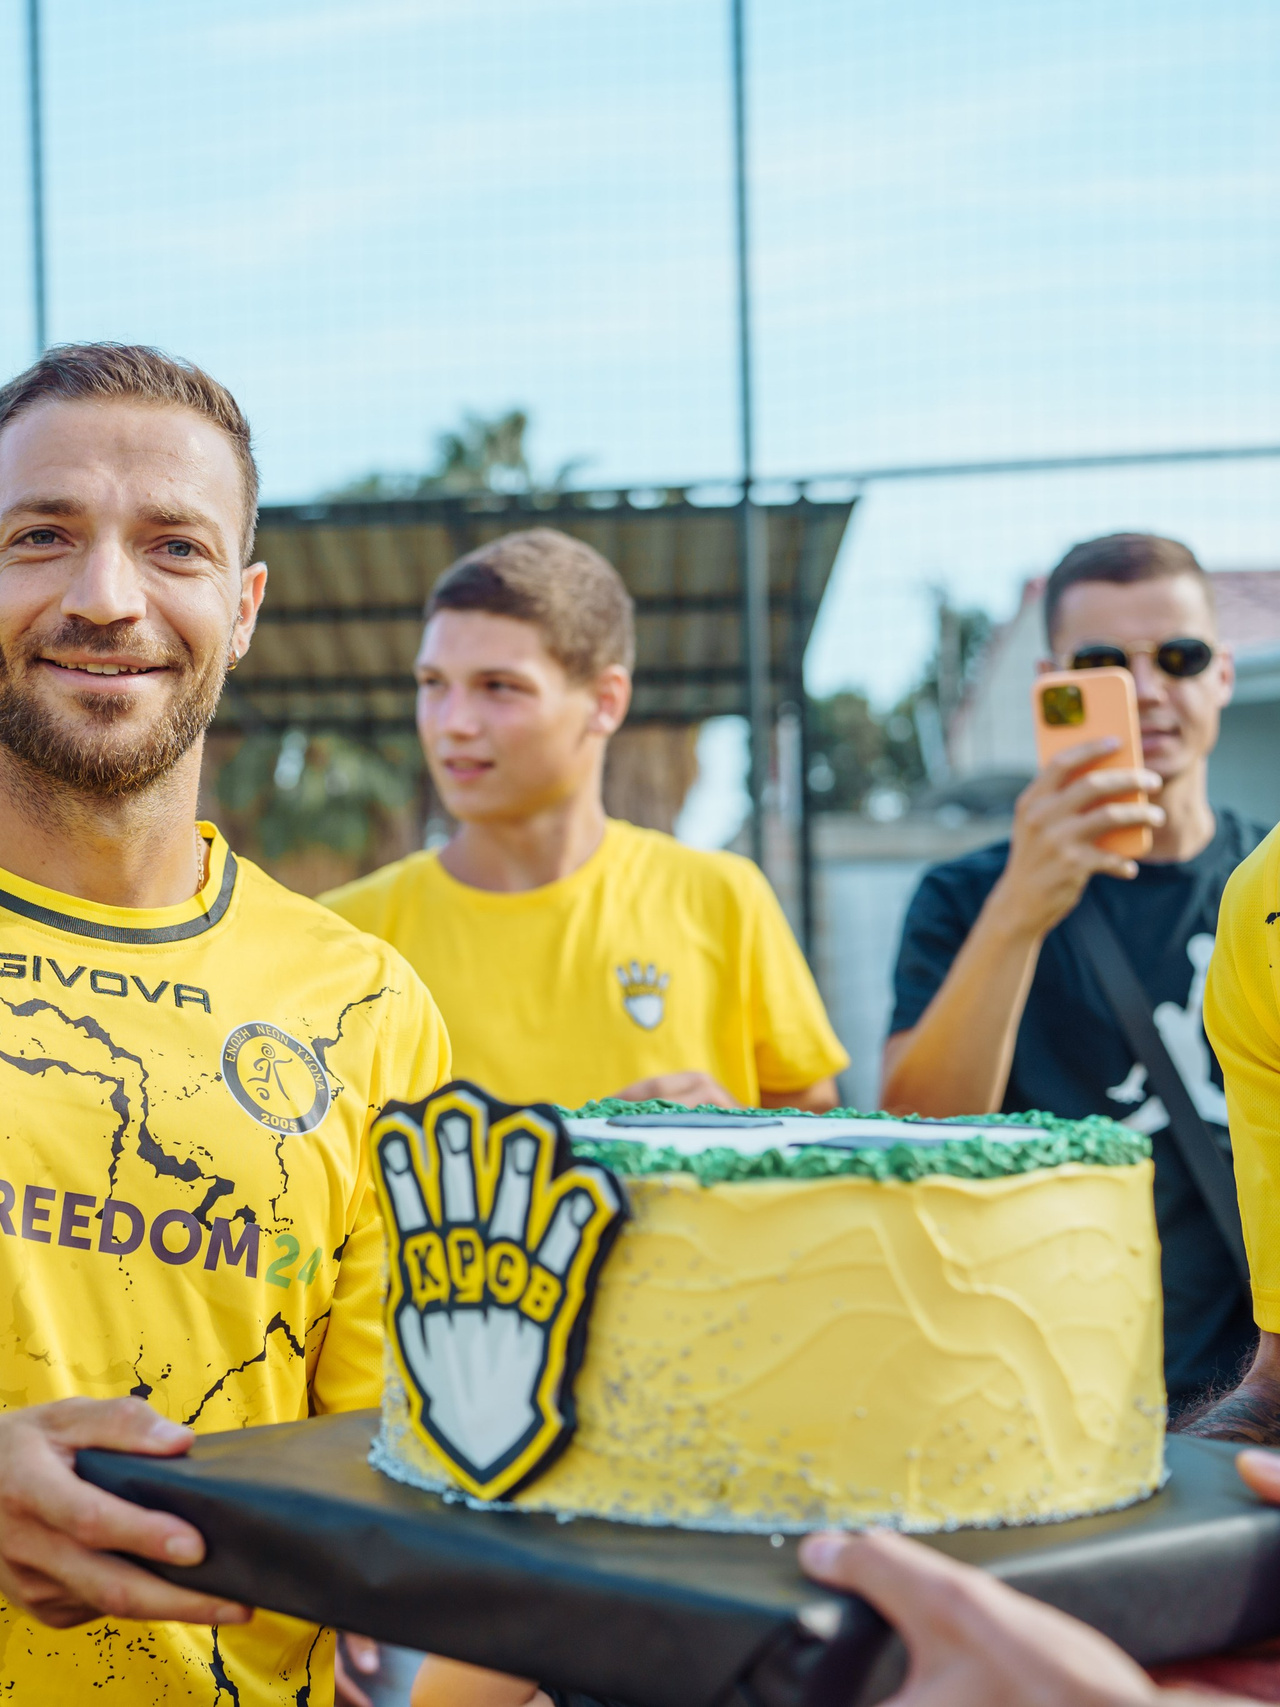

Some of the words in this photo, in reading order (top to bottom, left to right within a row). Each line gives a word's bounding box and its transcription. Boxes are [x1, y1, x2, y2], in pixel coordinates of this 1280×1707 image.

[224, 1028, 251, 1063] ΕΝΩΣΗ
[255, 1025, 289, 1046] ΝΕΩΝ
[296, 1045, 326, 1091] ΥΨΩΝΑ
[260, 1112, 298, 1132] 2005
